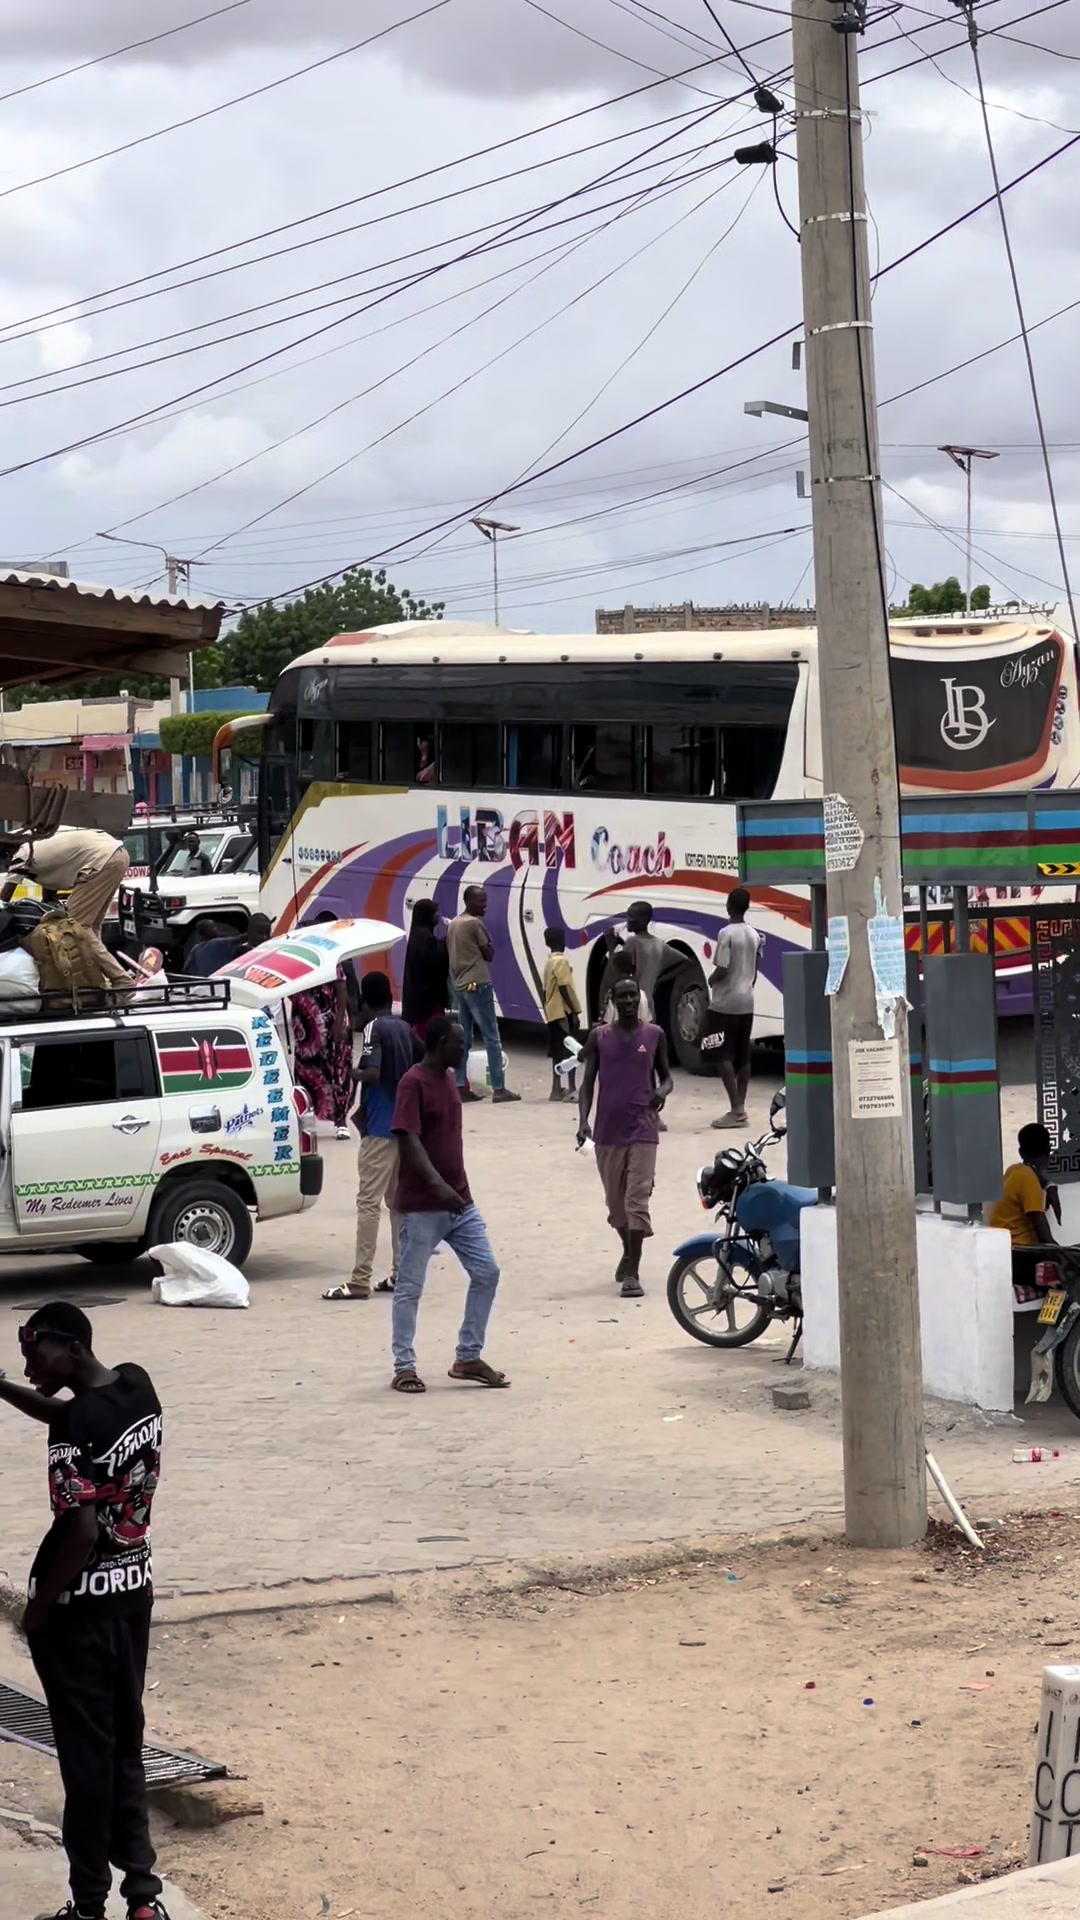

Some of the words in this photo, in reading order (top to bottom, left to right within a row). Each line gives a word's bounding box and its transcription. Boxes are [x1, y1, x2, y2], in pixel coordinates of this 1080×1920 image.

[590, 825, 675, 878] Coach
[159, 1147, 192, 1165] East
[200, 1143, 253, 1162] Special
[26, 1198, 46, 1214] My
[51, 1196, 101, 1212] Redeemer
[105, 1192, 134, 1206] Lives
